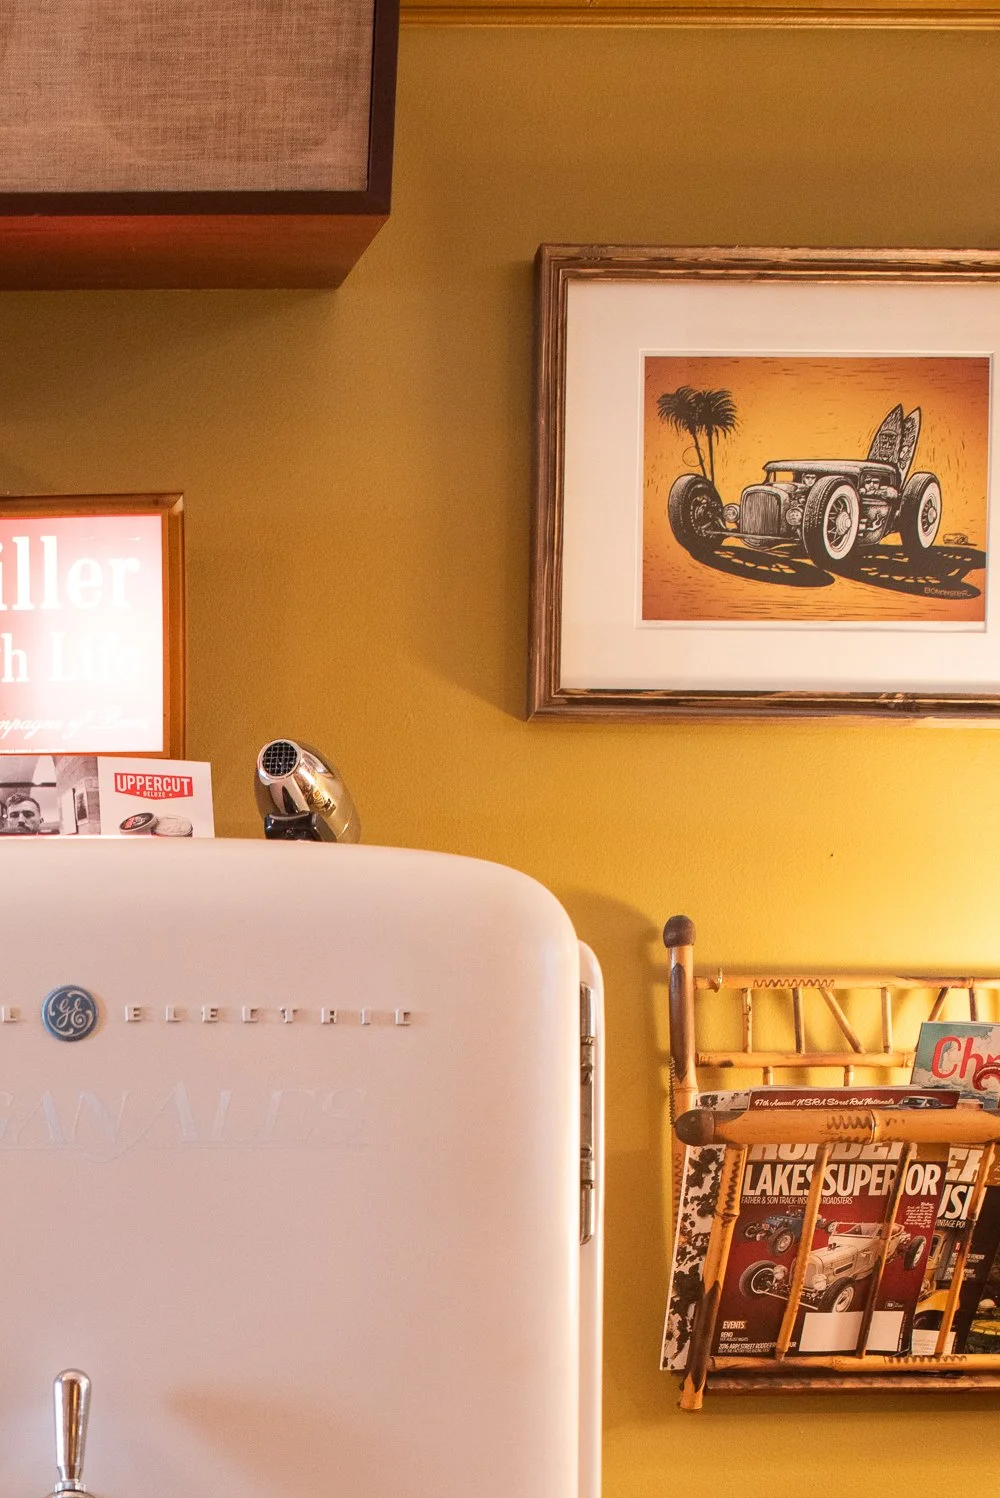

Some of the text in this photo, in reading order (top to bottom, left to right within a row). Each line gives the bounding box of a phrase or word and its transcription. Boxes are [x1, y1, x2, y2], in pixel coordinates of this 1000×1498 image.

[116, 774, 191, 796] UPPERCUT
[124, 1004, 412, 1026] ELECTRIC
[145, 1079, 370, 1148] ALES
[770, 1098, 796, 1107] Annual
[822, 1163, 942, 1197] SUPEROR
[741, 1196, 762, 1205] FATHER
[766, 1196, 779, 1205] SON
[822, 1196, 853, 1205] ROADSTERS
[722, 1320, 746, 1329] EVENTS
